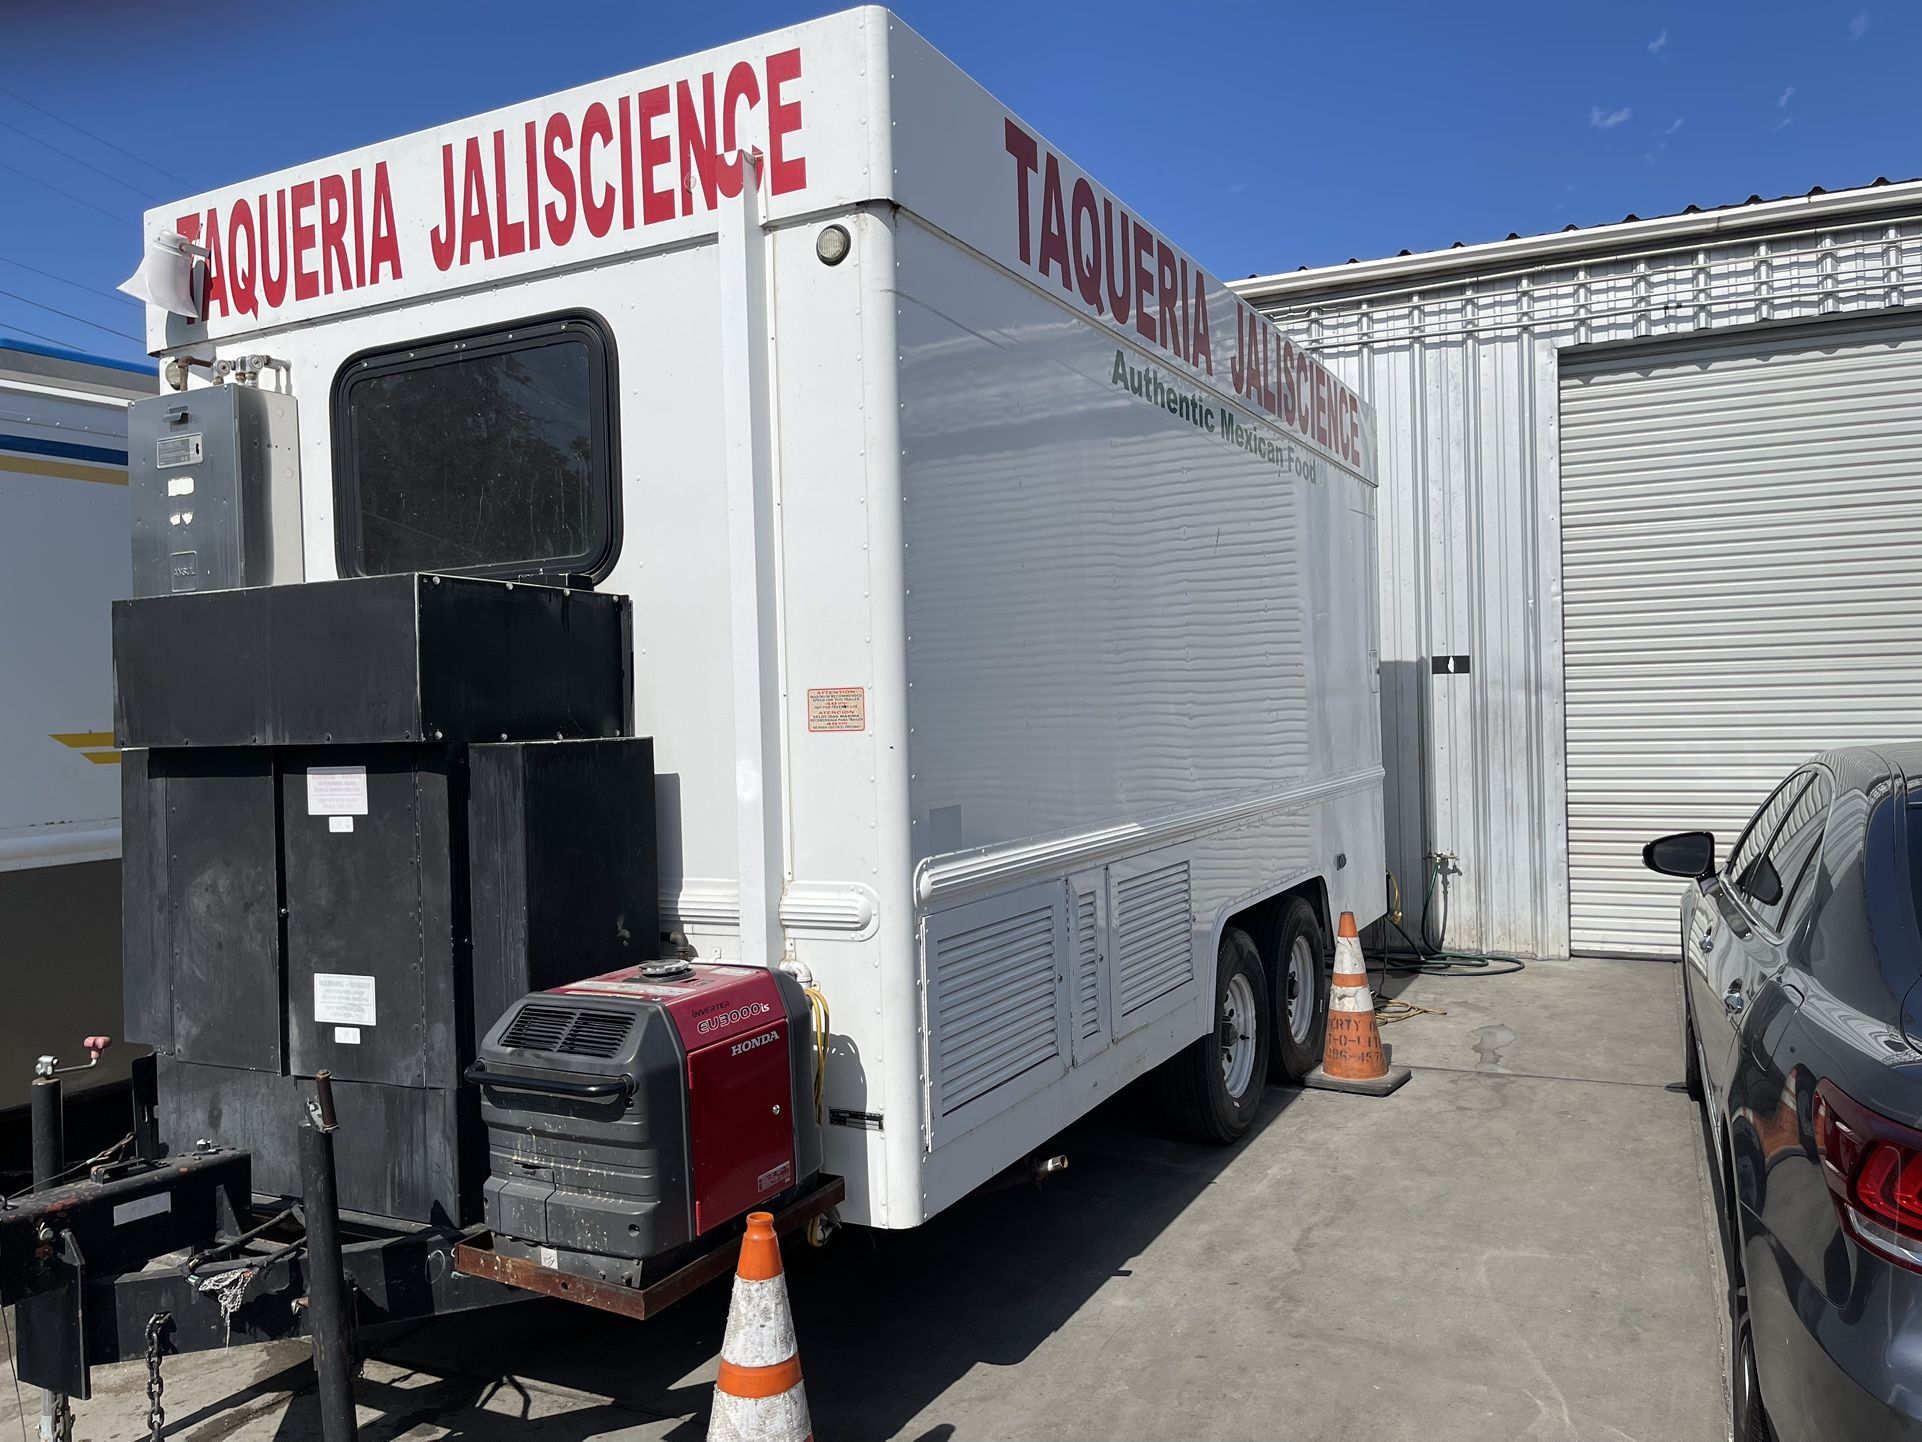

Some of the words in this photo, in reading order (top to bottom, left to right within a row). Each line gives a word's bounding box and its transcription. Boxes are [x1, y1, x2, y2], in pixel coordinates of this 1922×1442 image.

[430, 47, 807, 272] JALISCIENCE
[1004, 116, 1213, 377] TAQUERIA
[1230, 302, 1361, 468] JALISCIENCE
[1111, 349, 1215, 433] Authentic
[1220, 408, 1283, 469] Mexican
[1287, 445, 1317, 485] Food
[697, 1002, 770, 1035] EU3000is
[730, 1030, 780, 1057] HONDA
[1328, 1018, 1361, 1031] ERTY
